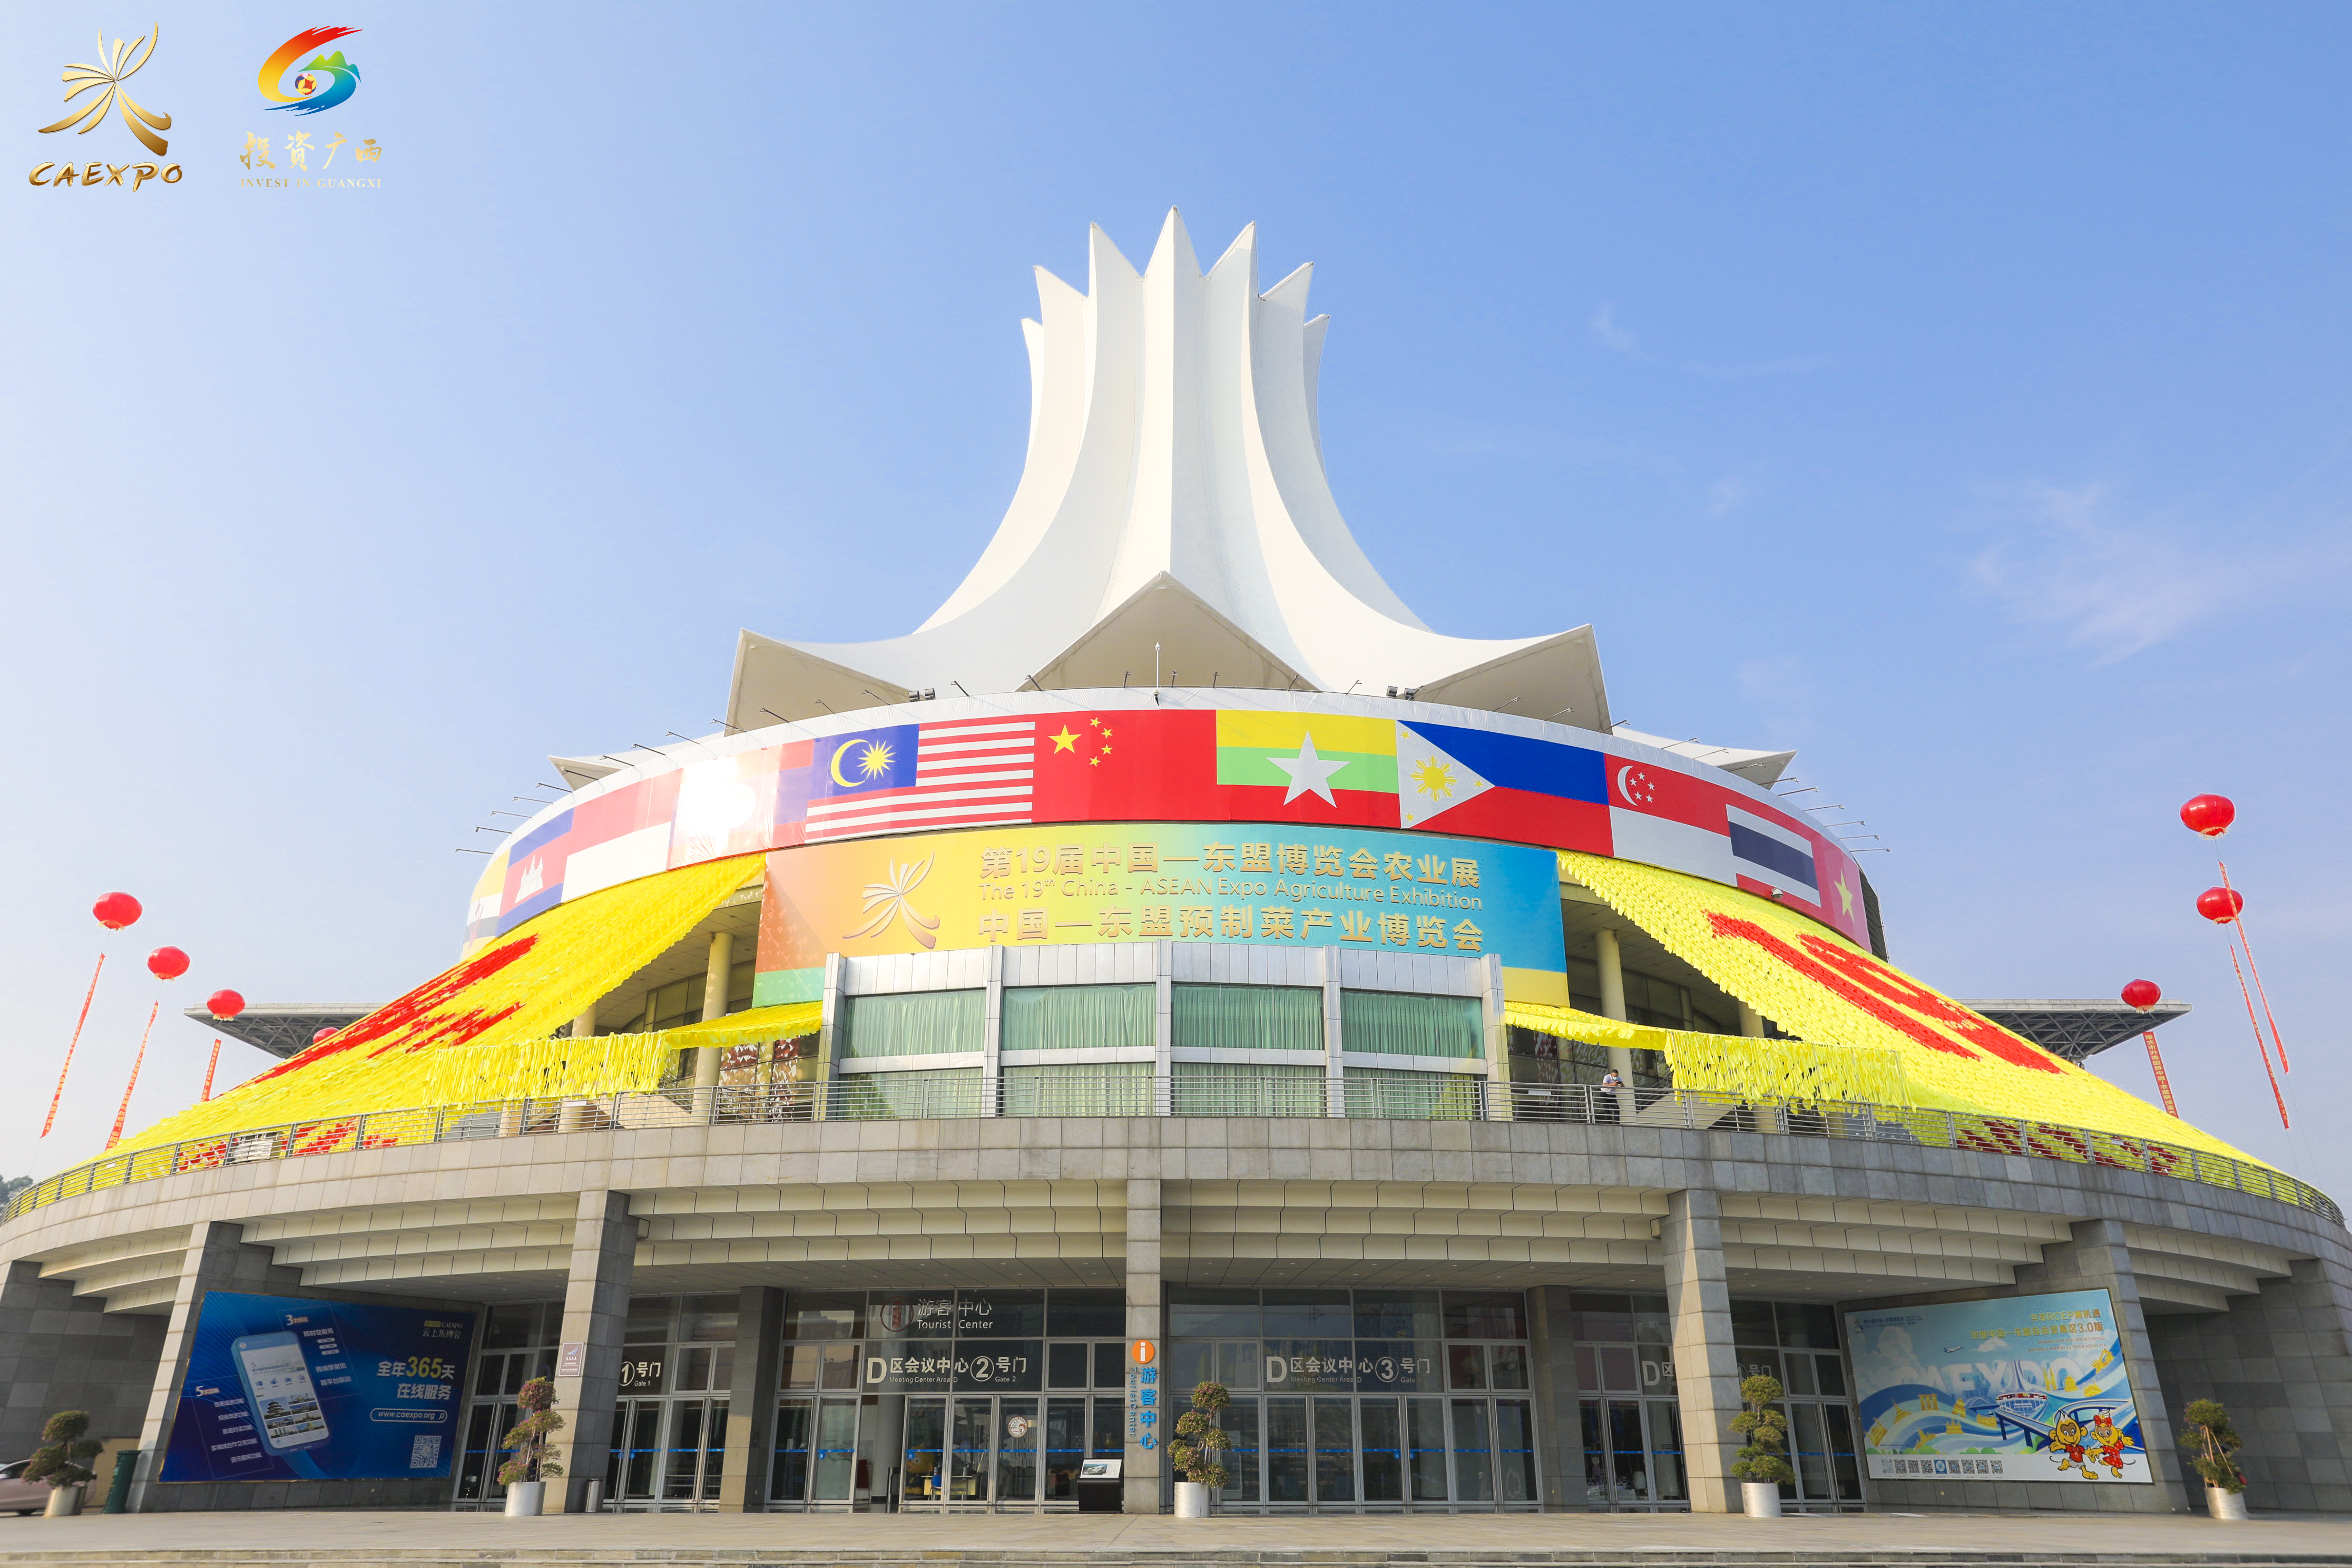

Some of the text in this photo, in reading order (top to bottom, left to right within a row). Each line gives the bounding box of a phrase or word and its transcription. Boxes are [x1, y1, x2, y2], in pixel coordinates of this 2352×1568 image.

[979, 882, 1015, 900] The
[1021, 876, 1055, 898] 19th
[1061, 877, 1119, 896] China
[1140, 877, 1212, 895] ASEAN
[1219, 877, 1267, 900] Expo
[1275, 878, 1385, 902] Agriculture
[1390, 885, 1483, 911] Exhibition
[917, 1298, 992, 1316] 游客中心
[917, 1319, 993, 1329] Tourist Center
[423, 1328, 461, 1339] 云上东博会
[377, 1357, 455, 1379] 全年365天
[397, 1383, 452, 1400] 在线服务
[378, 1411, 435, 1420] www.caexpo.org
[1140, 1367, 1158, 1449] 游客中心
